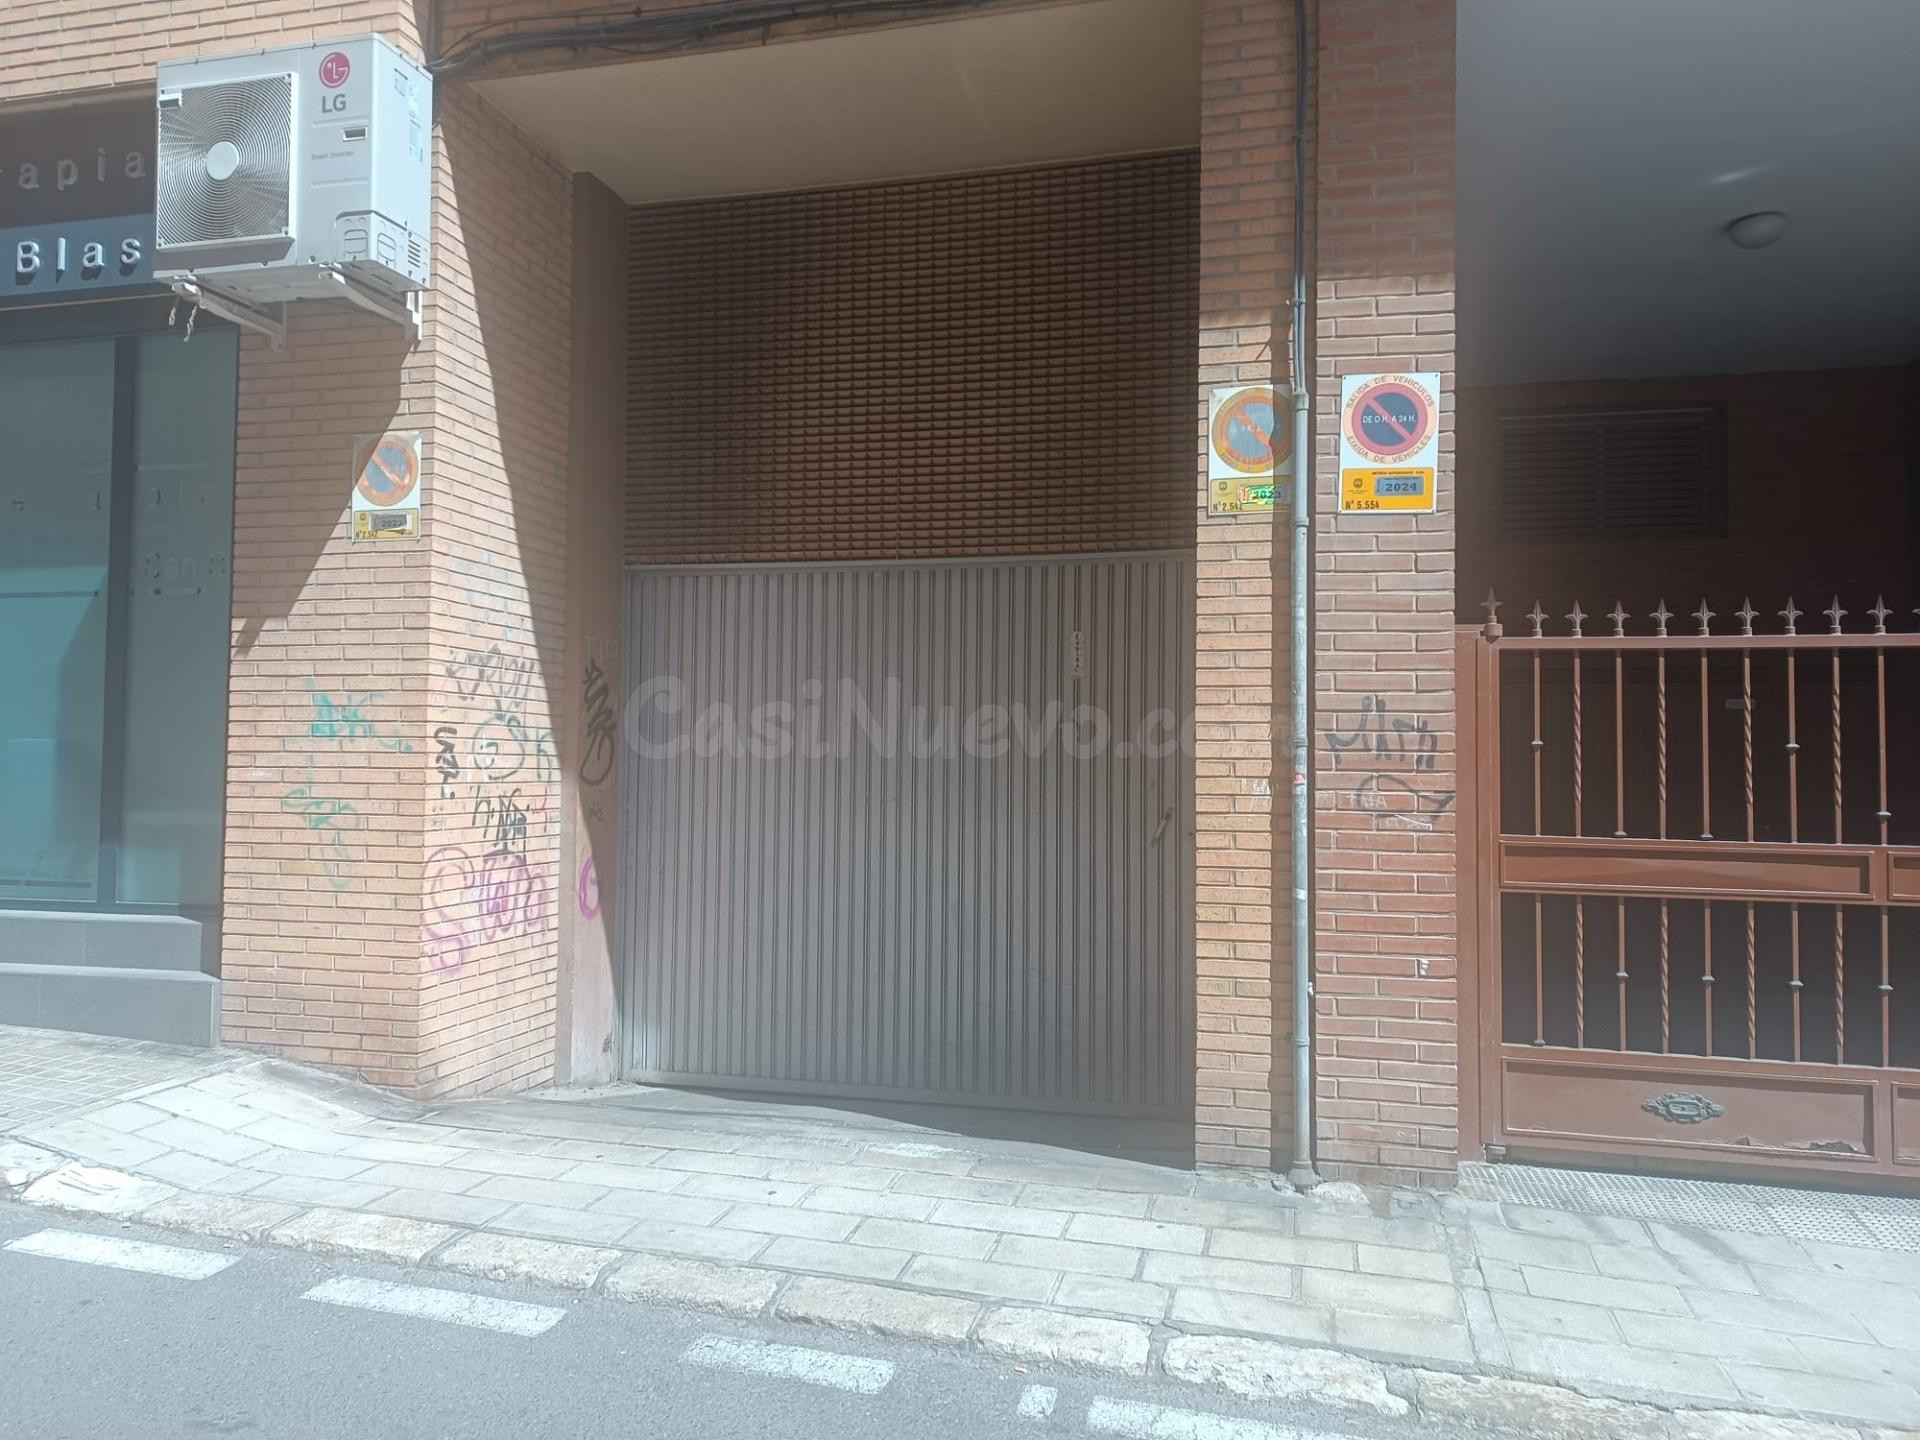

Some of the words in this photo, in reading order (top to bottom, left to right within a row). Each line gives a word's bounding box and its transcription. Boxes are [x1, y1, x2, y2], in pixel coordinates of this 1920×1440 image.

[321, 94, 346, 113] LG
[0, 148, 146, 191] apia
[16, 237, 141, 273] Blas
[1363, 415, 1373, 423] DE
[1385, 482, 1417, 492] 2024
[1357, 500, 1380, 510] 5.554
